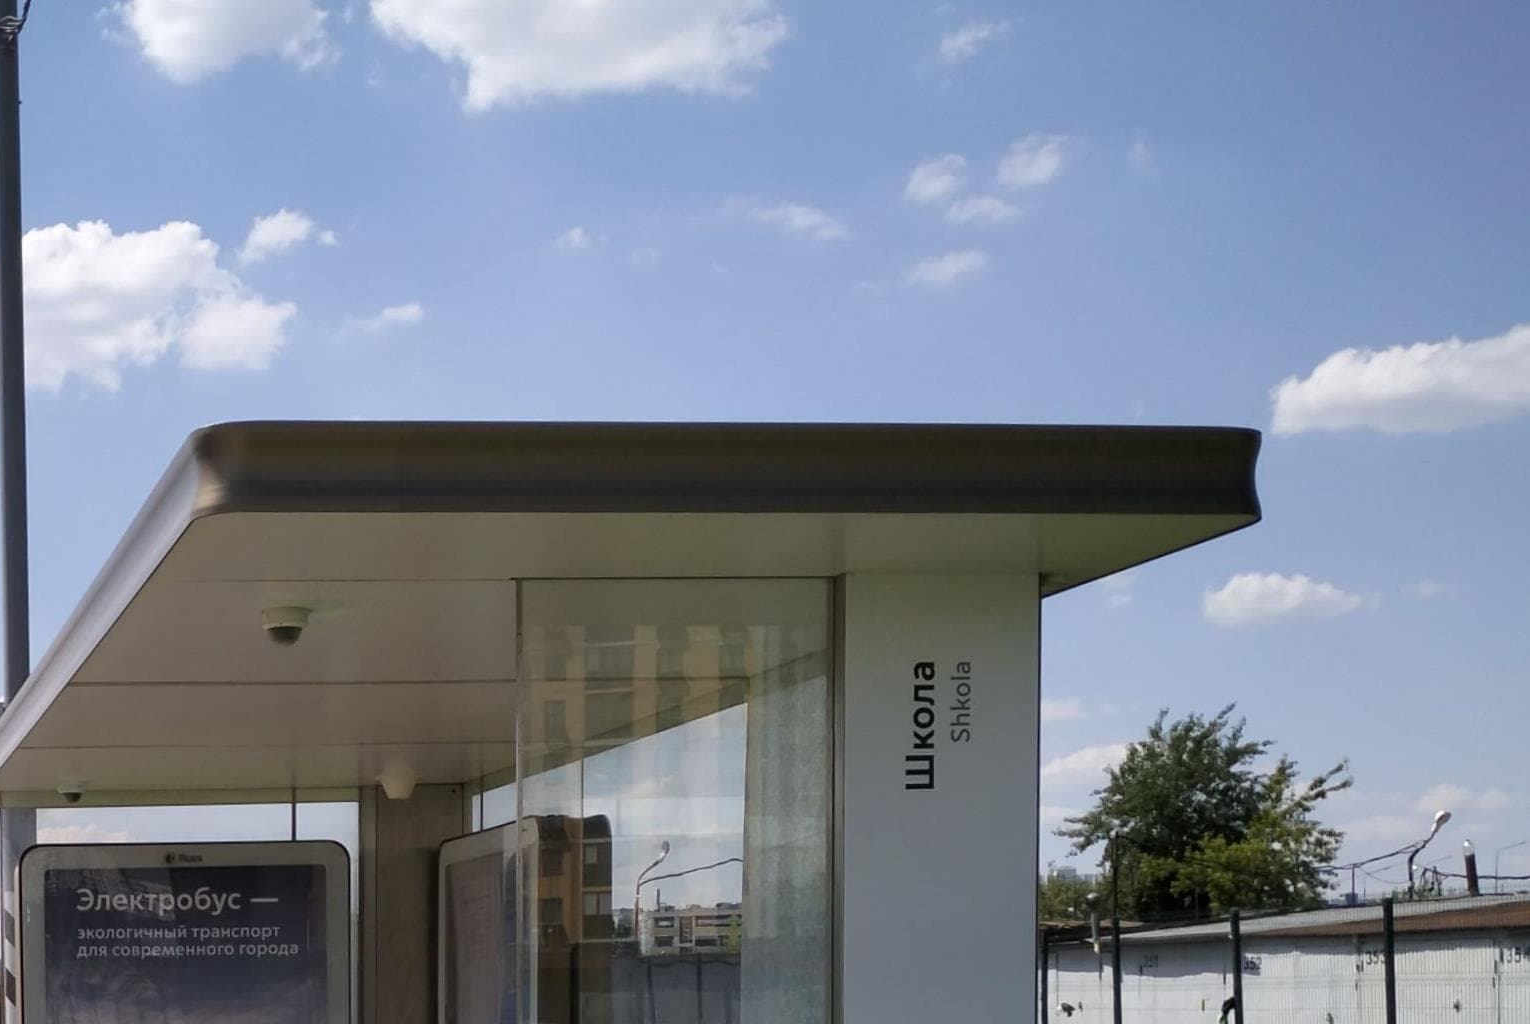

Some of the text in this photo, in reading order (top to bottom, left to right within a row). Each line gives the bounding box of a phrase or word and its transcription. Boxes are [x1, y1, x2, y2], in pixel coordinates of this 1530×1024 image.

[950, 661, 971, 743] Shkola
[905, 661, 935, 790] Школа
[76, 887, 241, 915] Электробус
[77, 925, 280, 941] экологичный транспорт
[76, 943, 299, 959] для современного города
